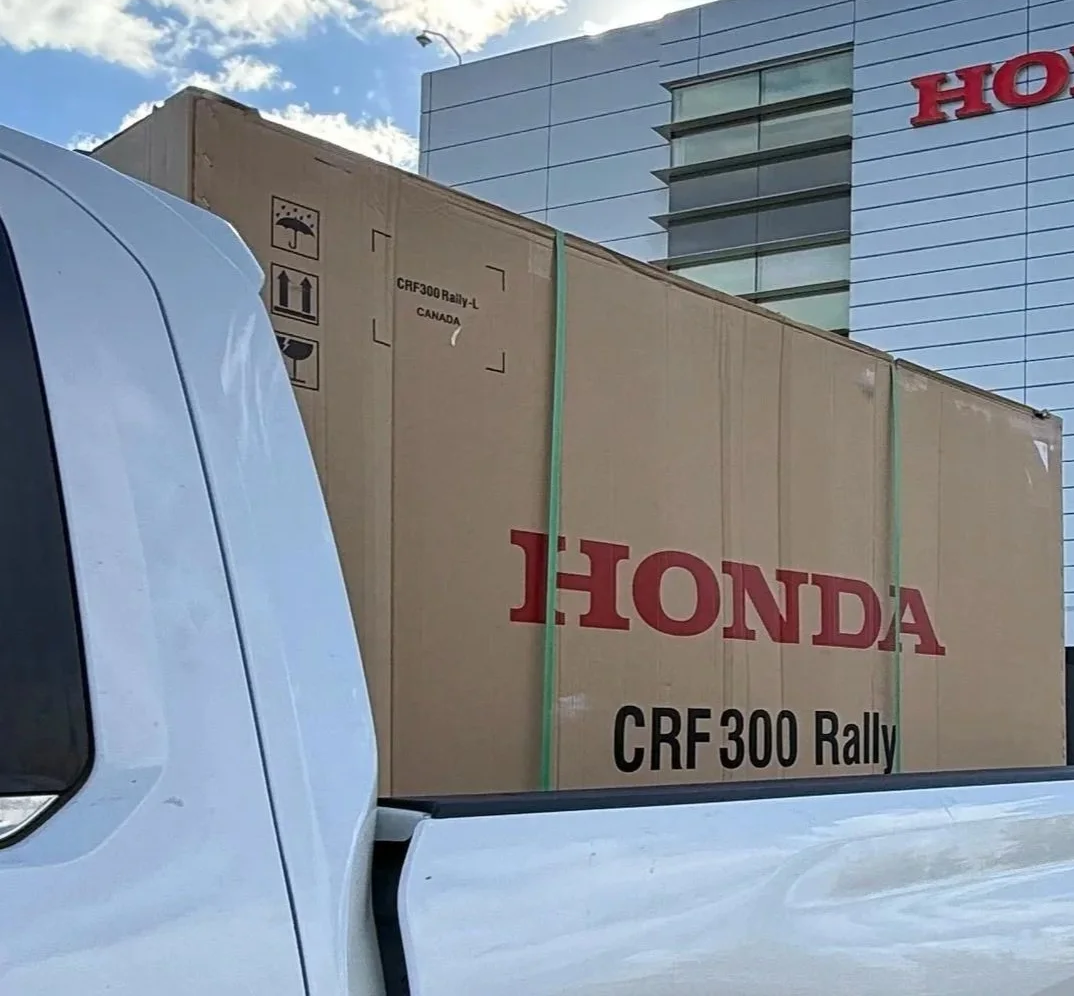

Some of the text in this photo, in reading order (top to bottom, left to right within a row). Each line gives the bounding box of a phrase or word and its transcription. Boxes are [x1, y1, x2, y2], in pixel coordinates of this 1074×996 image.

[396, 277, 440, 299] CRF300
[416, 307, 461, 326] CANADA
[510, 529, 946, 656] HONDA
[815, 710, 896, 774] Rally
